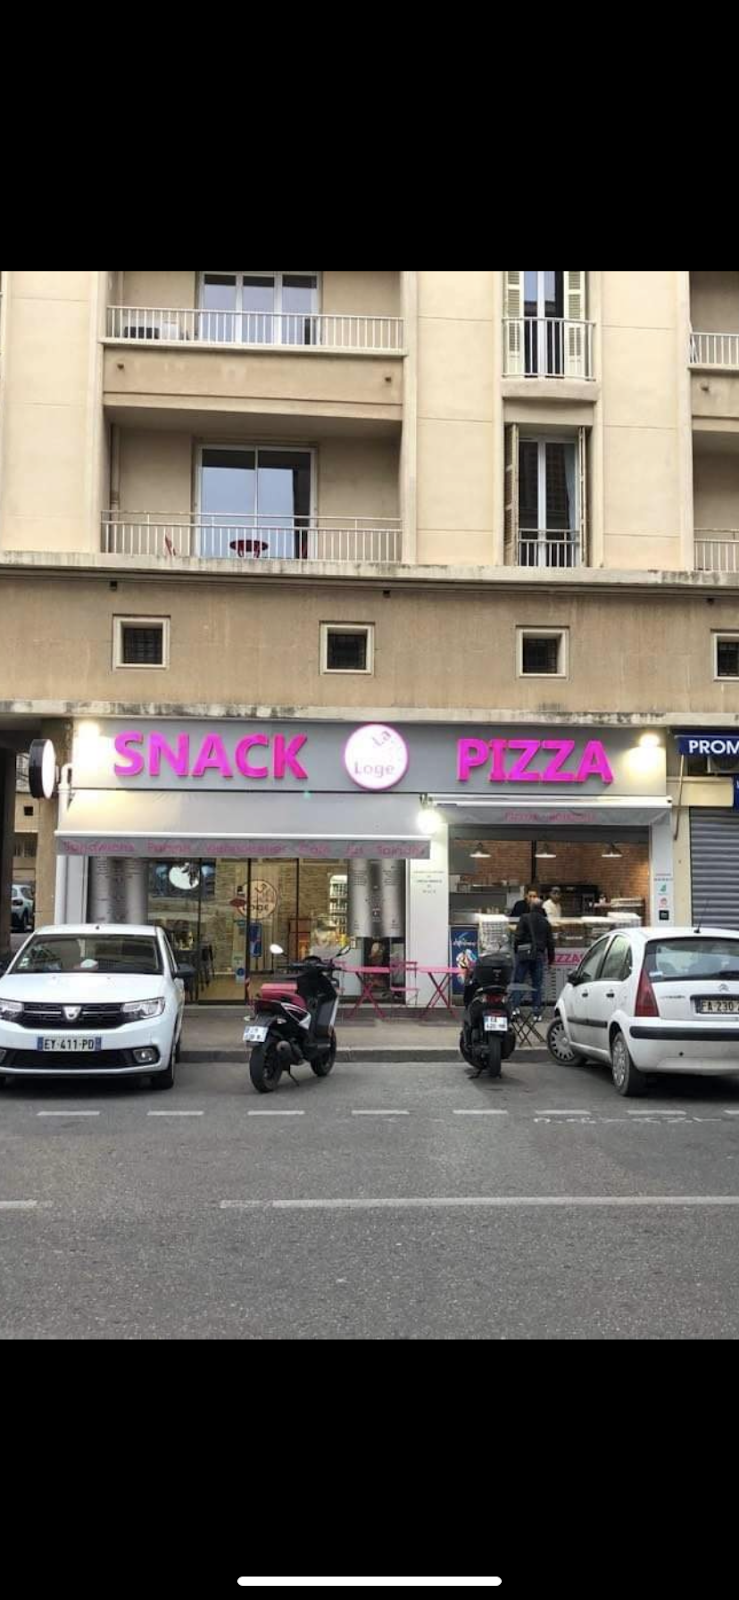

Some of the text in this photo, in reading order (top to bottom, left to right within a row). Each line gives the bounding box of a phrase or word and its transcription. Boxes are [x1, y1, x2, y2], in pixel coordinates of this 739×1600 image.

[371, 730, 392, 747] La
[688, 740, 739, 754] PROM
[114, 731, 308, 779] SNACK
[457, 738, 613, 783] PIZZA
[354, 761, 395, 778] Loge
